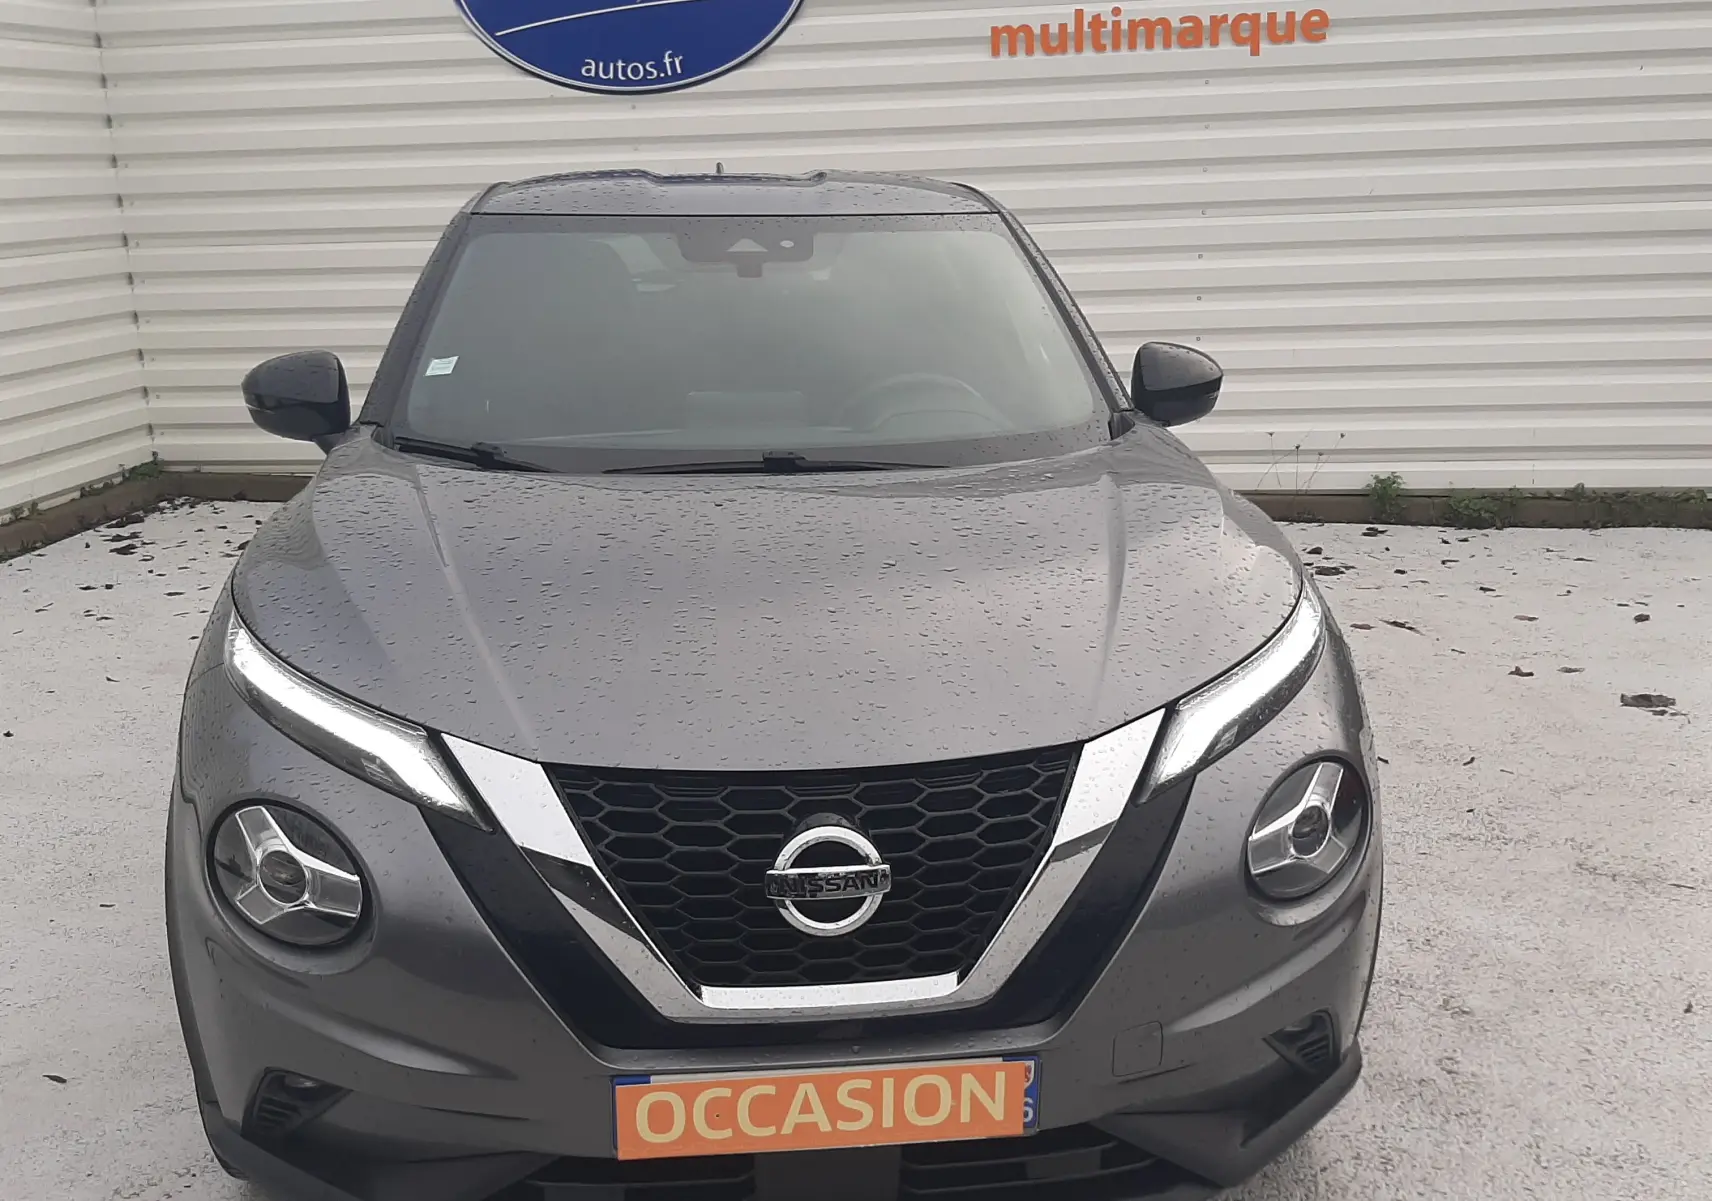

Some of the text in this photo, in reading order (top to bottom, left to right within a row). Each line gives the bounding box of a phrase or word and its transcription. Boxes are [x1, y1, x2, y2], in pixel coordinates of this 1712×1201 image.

[990, 6, 1330, 57] multimarque
[581, 50, 683, 80] autos.fr
[779, 873, 879, 895] NISSAN
[635, 1070, 1006, 1144] OCCASION
